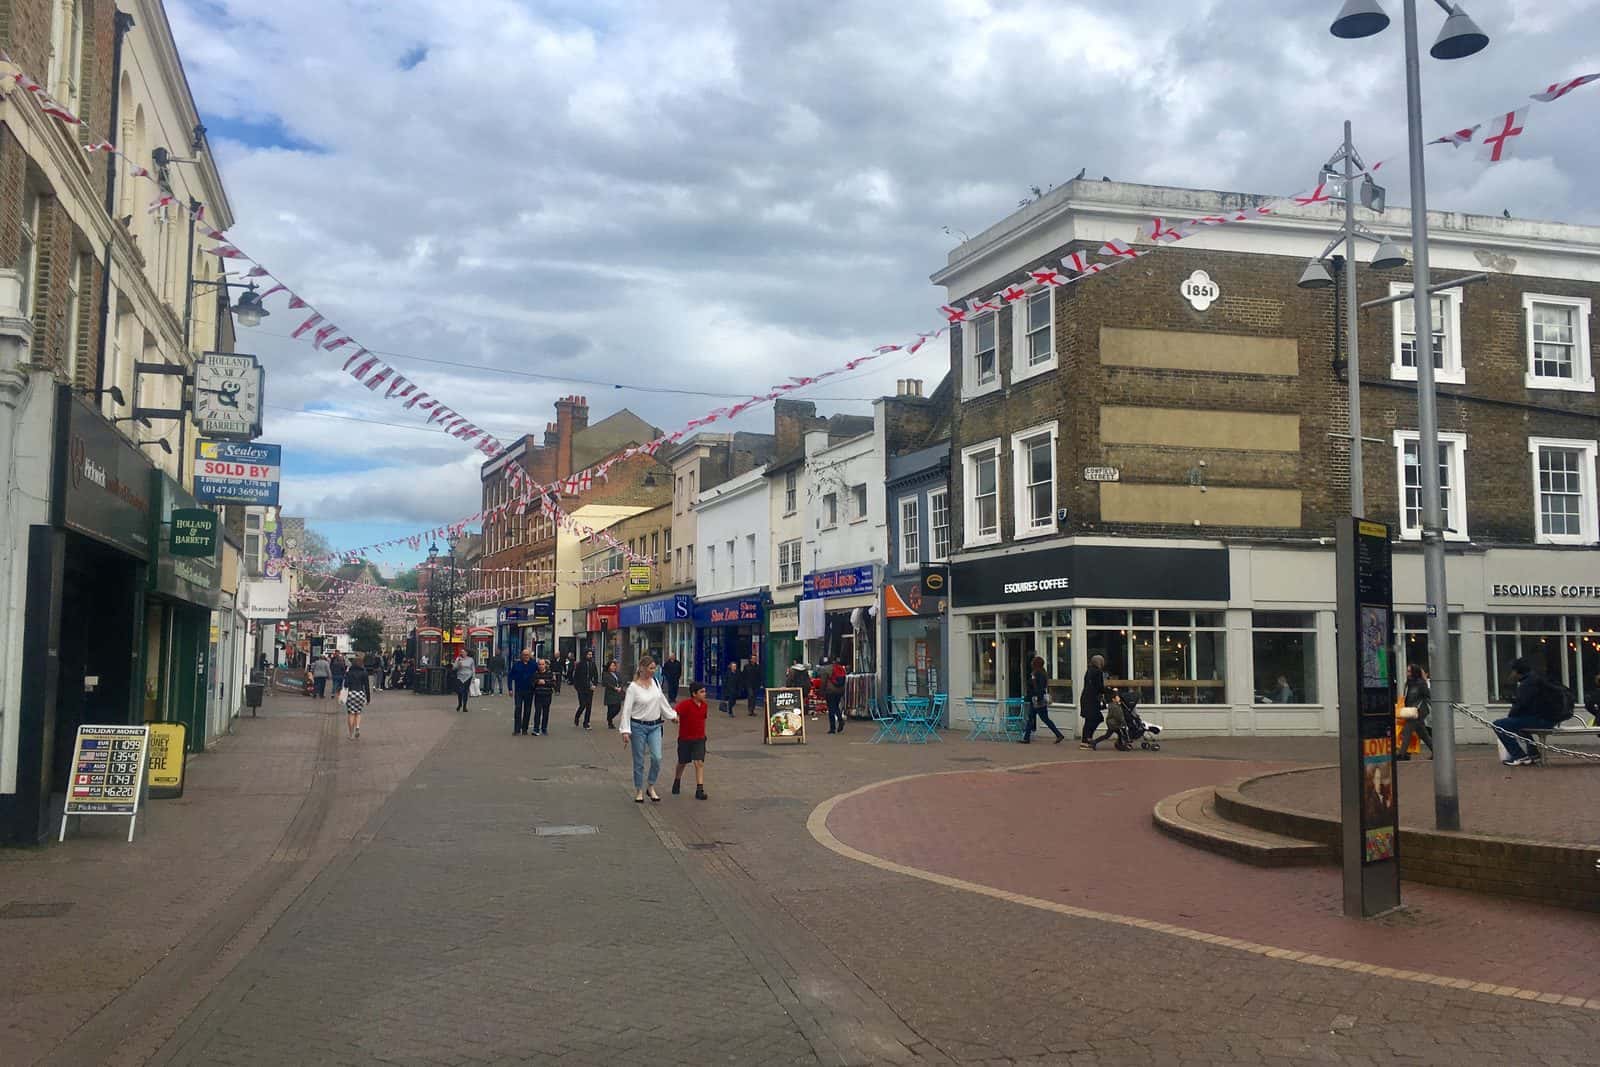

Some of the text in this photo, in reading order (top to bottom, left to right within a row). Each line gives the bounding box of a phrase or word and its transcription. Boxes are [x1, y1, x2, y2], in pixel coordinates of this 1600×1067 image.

[1187, 284, 1214, 297] 1851
[208, 356, 250, 369] HOLLAND
[206, 420, 248, 433] BARRETT
[224, 444, 269, 459] Sealeys
[205, 462, 270, 478] SOLD BY
[176, 520, 212, 530] HOLLAND
[175, 536, 210, 546] BARRETT
[1004, 577, 1069, 594] ESQUIRES COFFEE
[1493, 584, 1557, 597] ESQUIRES
[1364, 738, 1392, 756] LOVE
[149, 757, 168, 769] ERE
